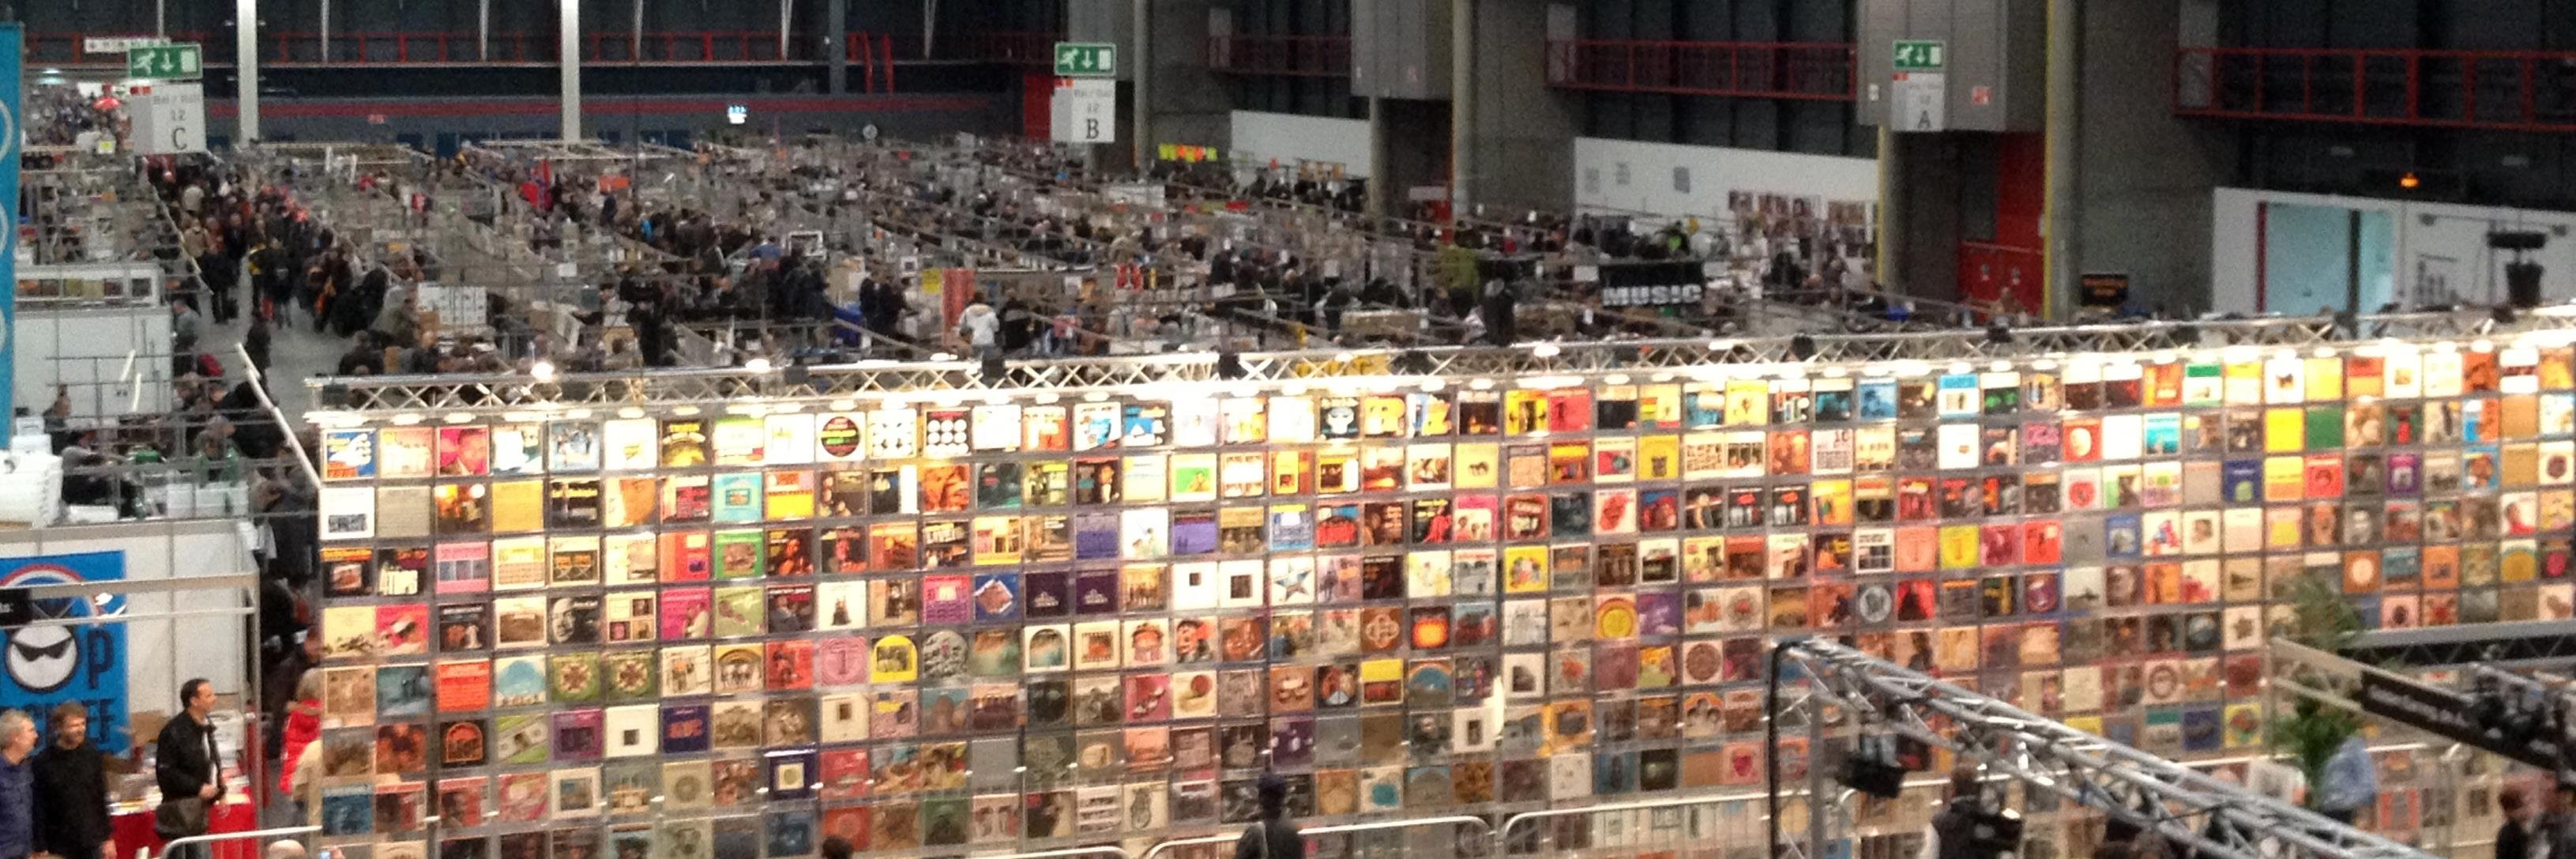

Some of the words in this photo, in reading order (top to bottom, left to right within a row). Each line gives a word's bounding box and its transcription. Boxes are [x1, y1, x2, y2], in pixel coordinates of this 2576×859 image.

[1086, 118, 1100, 139] B
[1917, 110, 1931, 130] A
[171, 126, 188, 151] C
[1603, 284, 1702, 307] MUSIC
